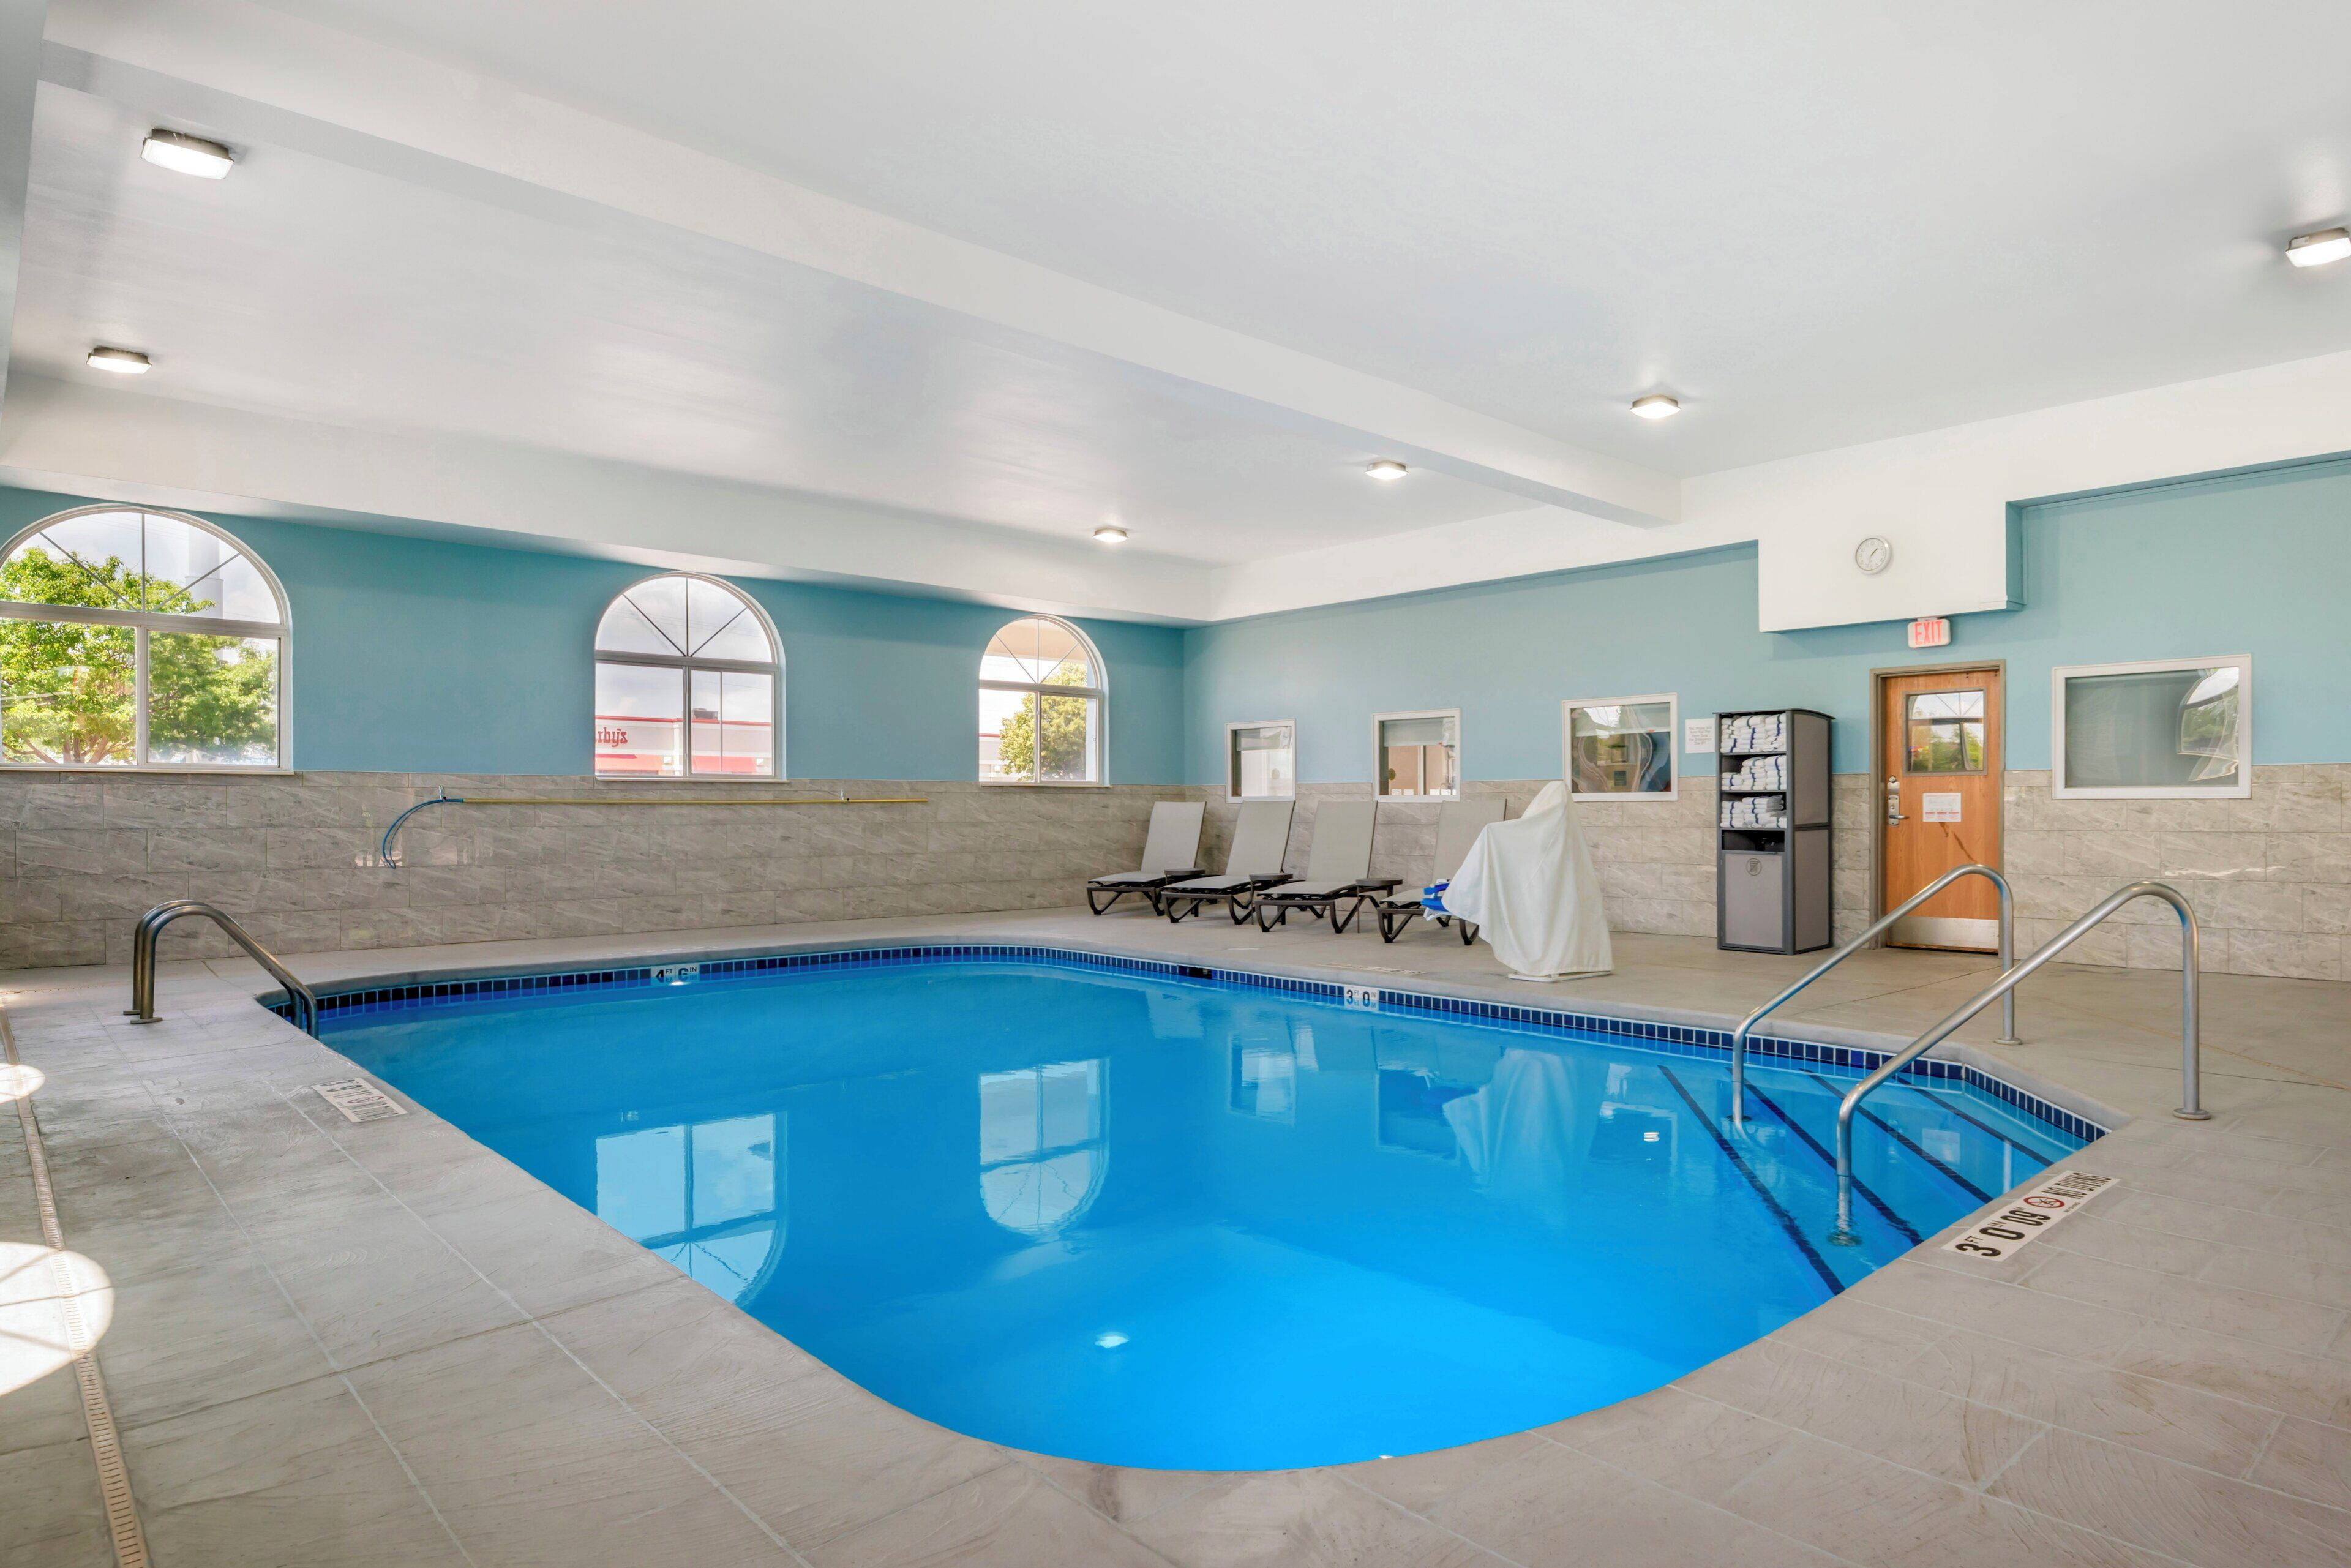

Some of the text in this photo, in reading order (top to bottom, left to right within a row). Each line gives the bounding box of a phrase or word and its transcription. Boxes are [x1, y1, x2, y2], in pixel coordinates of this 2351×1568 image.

[1914, 621, 1943, 645] EXIT
[596, 727, 628, 748] rby's
[2054, 1172, 2112, 1191] DIVING
[2041, 1187, 2087, 1199] NO
[2000, 1209, 2052, 1226] 0.9
[1964, 1235, 1984, 1244] FT
[1979, 1226, 2025, 1240] 0
[1955, 1242, 2001, 1257] 3
